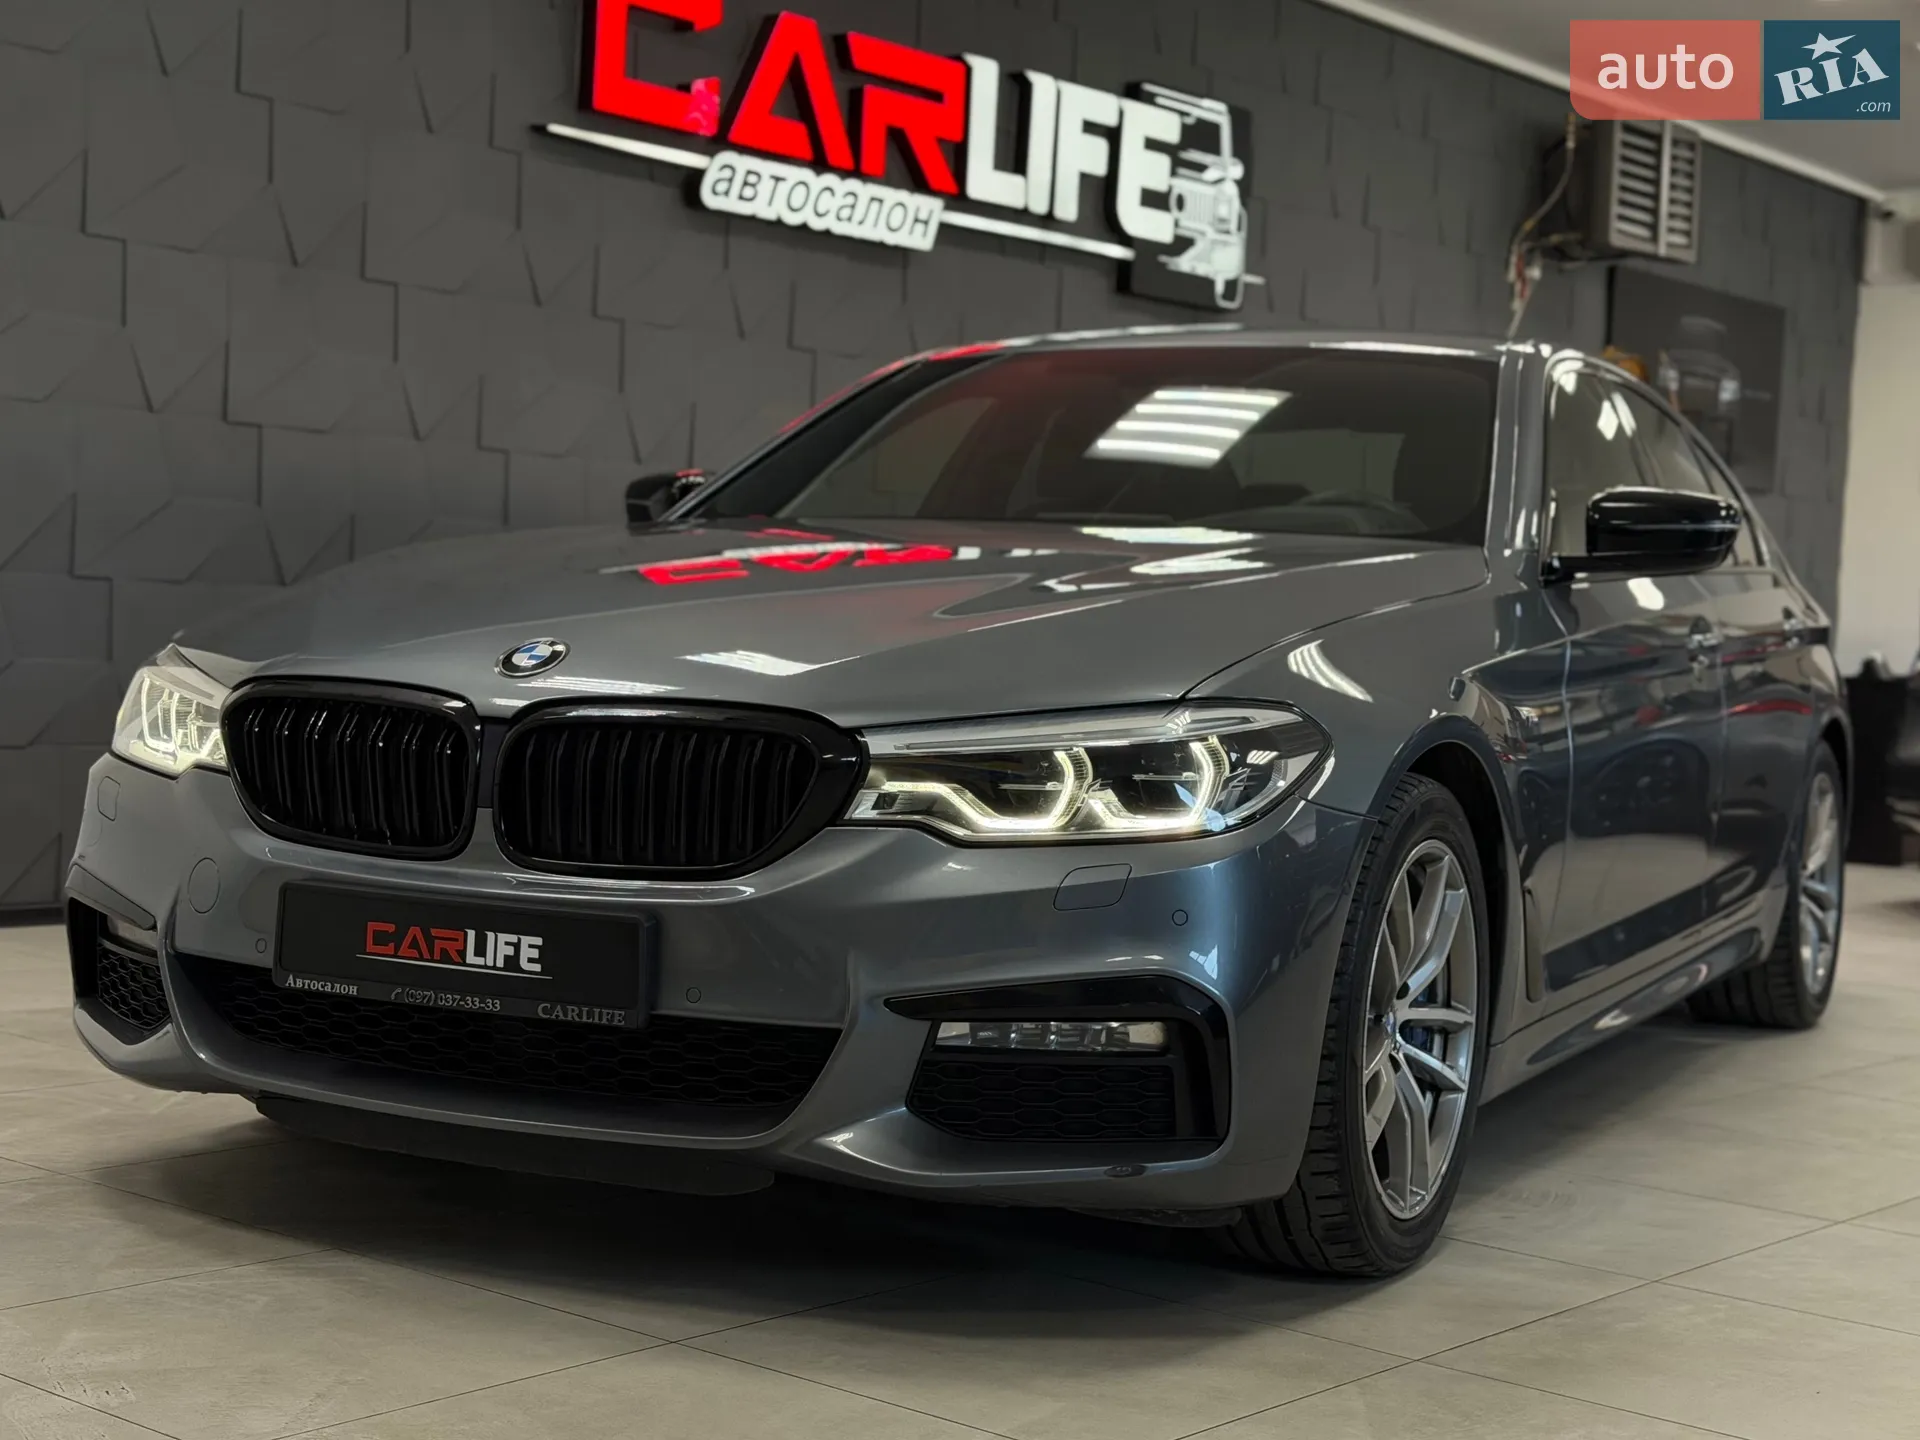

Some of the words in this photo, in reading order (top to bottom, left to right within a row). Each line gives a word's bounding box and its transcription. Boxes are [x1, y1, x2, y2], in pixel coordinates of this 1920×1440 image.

[590, 0, 1182, 244] CARLIFE
[710, 163, 934, 239] автосалон
[365, 921, 543, 972] CARLIFE
[285, 973, 358, 996] Автосалон
[403, 987, 435, 1006] (097)
[438, 993, 501, 1012] 037-33-33
[537, 1003, 626, 1026] CARLIFE
